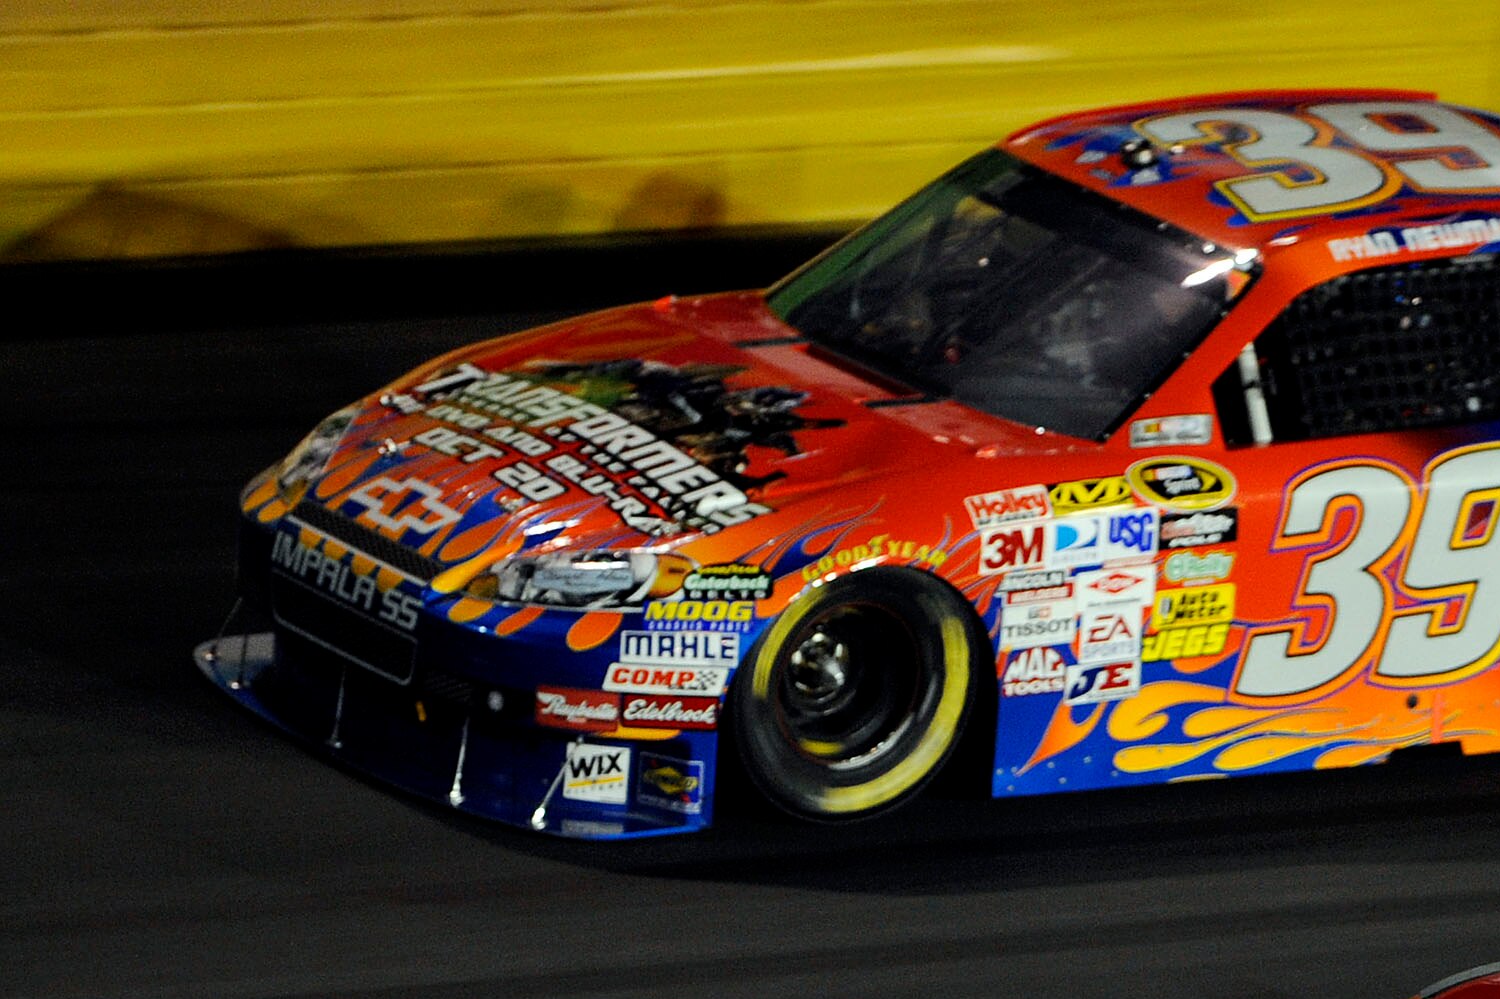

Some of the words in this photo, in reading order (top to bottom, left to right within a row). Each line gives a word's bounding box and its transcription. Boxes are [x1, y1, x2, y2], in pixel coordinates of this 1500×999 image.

[414, 362, 775, 528] TRANSFORMERS
[482, 426, 553, 457] AND
[413, 426, 506, 463] OCT
[493, 461, 569, 503] 20
[983, 526, 1045, 570] 3M
[1109, 511, 1153, 554] USG
[271, 530, 376, 611] IMPALA
[378, 587, 426, 631] SS
[644, 600, 755, 622] MOOG
[1002, 617, 1073, 638] TISSOT
[1087, 615, 1134, 643] EA
[624, 633, 736, 661] MAHLE
[611, 668, 696, 688] COMP
[1002, 646, 1066, 683] MAC
[1069, 662, 1133, 700] JE
[623, 698, 718, 724] Edelbrock
[570, 752, 623, 779] WIX
